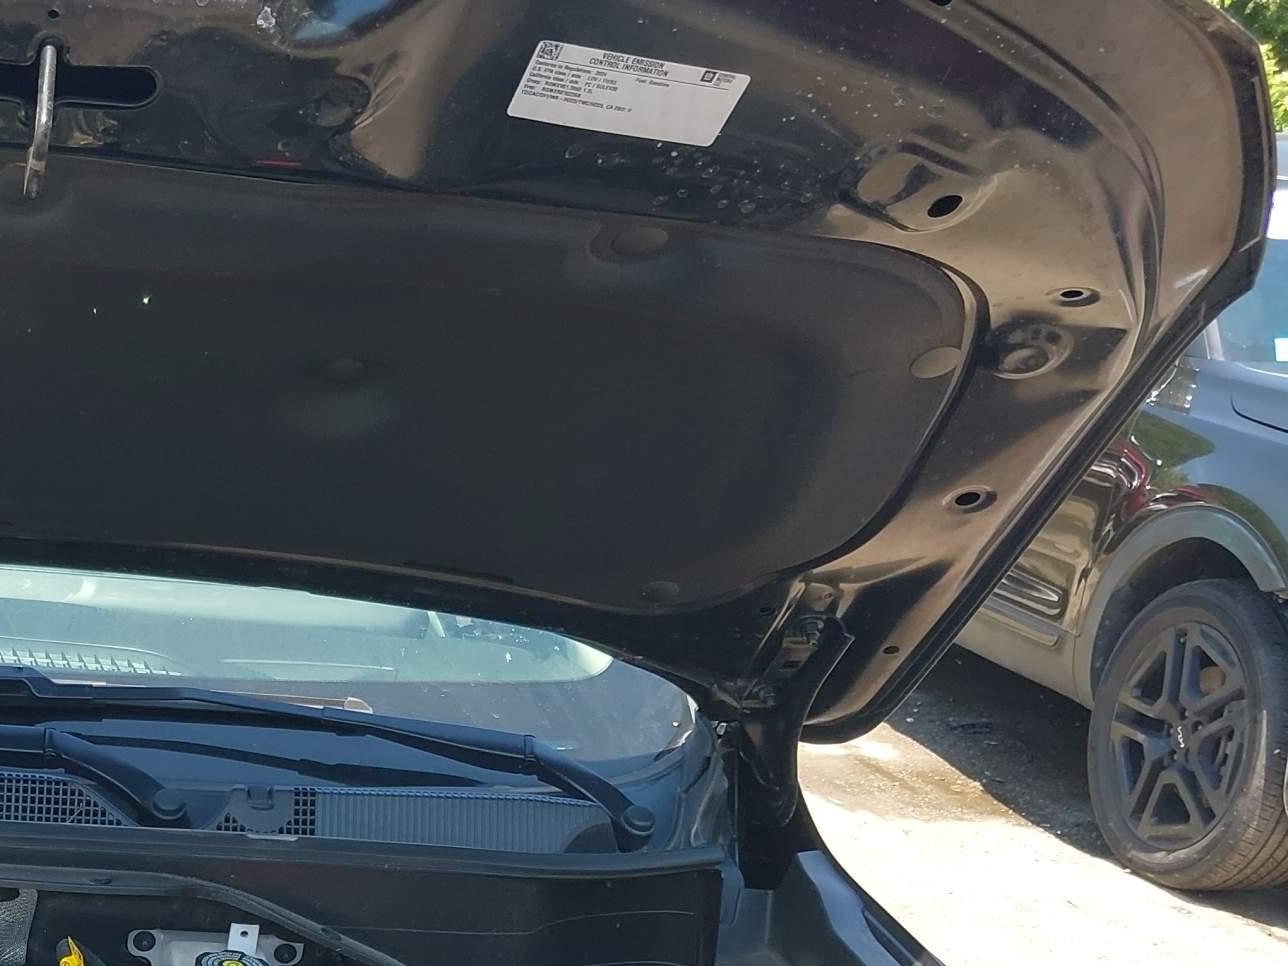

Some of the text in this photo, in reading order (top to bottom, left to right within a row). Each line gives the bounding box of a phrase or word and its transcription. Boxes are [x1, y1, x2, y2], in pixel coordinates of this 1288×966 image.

[589, 57, 619, 69] CONTROL
[621, 63, 669, 77] INFORMATION
[602, 52, 665, 69] VEHICLE EMISSION
